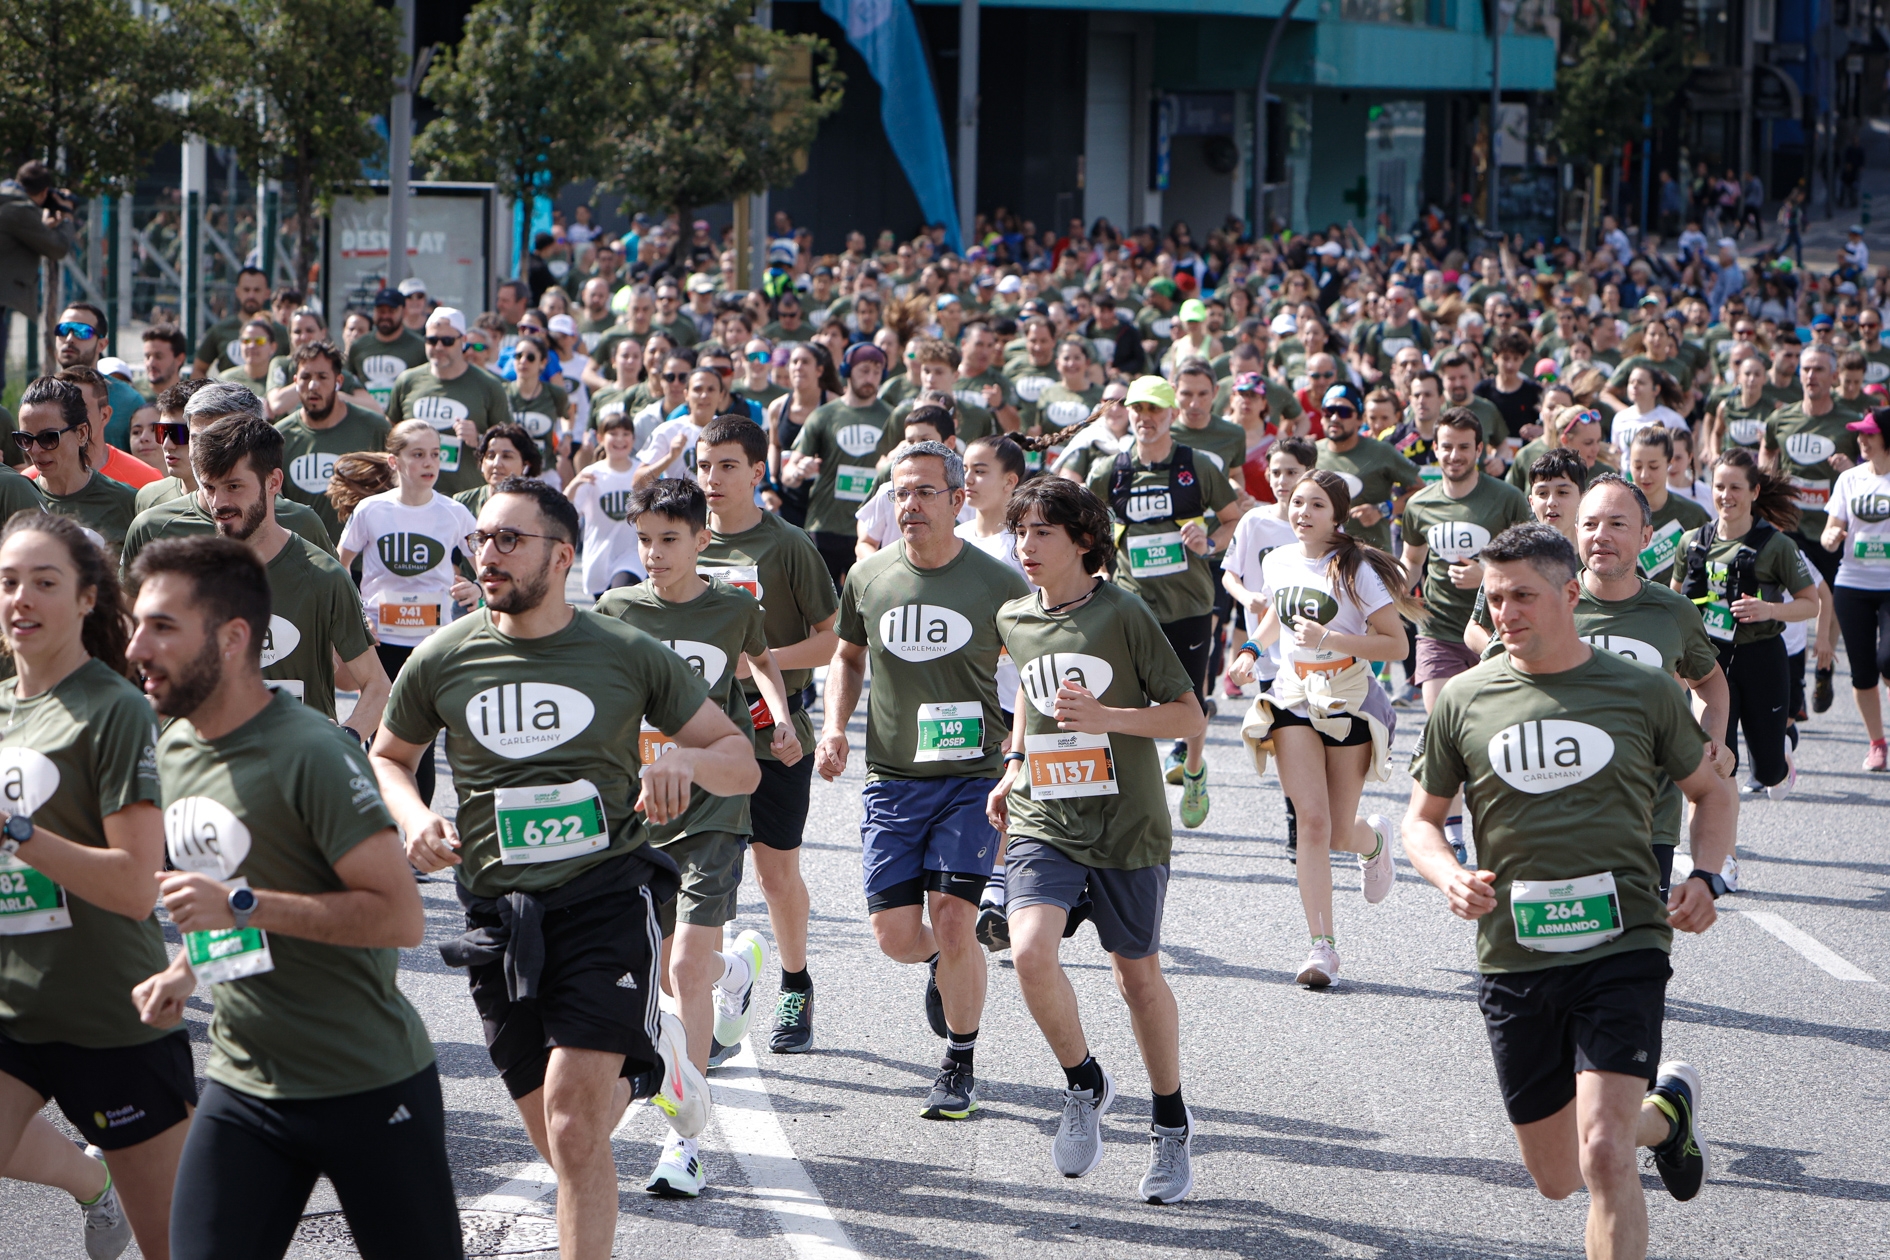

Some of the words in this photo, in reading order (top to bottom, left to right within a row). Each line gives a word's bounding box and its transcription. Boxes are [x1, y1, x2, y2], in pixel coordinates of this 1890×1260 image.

[341, 229, 446, 254] DESVLAT
[419, 396, 454, 419] illa
[843, 424, 875, 445] illa
[1792, 433, 1822, 454] illa
[296, 454, 335, 481] illa
[1855, 494, 1890, 515] illa
[1434, 521, 1473, 549] illa
[384, 532, 430, 562] illa
[1147, 547, 1167, 558] 120
[1653, 538, 1674, 556] 553
[1143, 556, 1173, 567] ALBERT
[399, 606, 421, 617] 941
[1277, 586, 1320, 619] illa
[889, 604, 948, 643] illa
[1028, 654, 1087, 699] illa
[480, 683, 560, 736] illa
[940, 721, 963, 735] 149
[500, 734, 560, 746] CARLEMANY
[937, 737, 965, 747] JOSEP
[1502, 720, 1582, 773] illa
[1046, 760, 1095, 784] 1137
[1523, 770, 1582, 783] CARLEMANY
[173, 797, 223, 857] illa
[523, 815, 585, 846] 622
[0, 872, 28, 894] 82
[0, 896, 37, 914] ARLA
[1544, 901, 1586, 920] 264
[1536, 919, 1601, 935] ARMANDO
